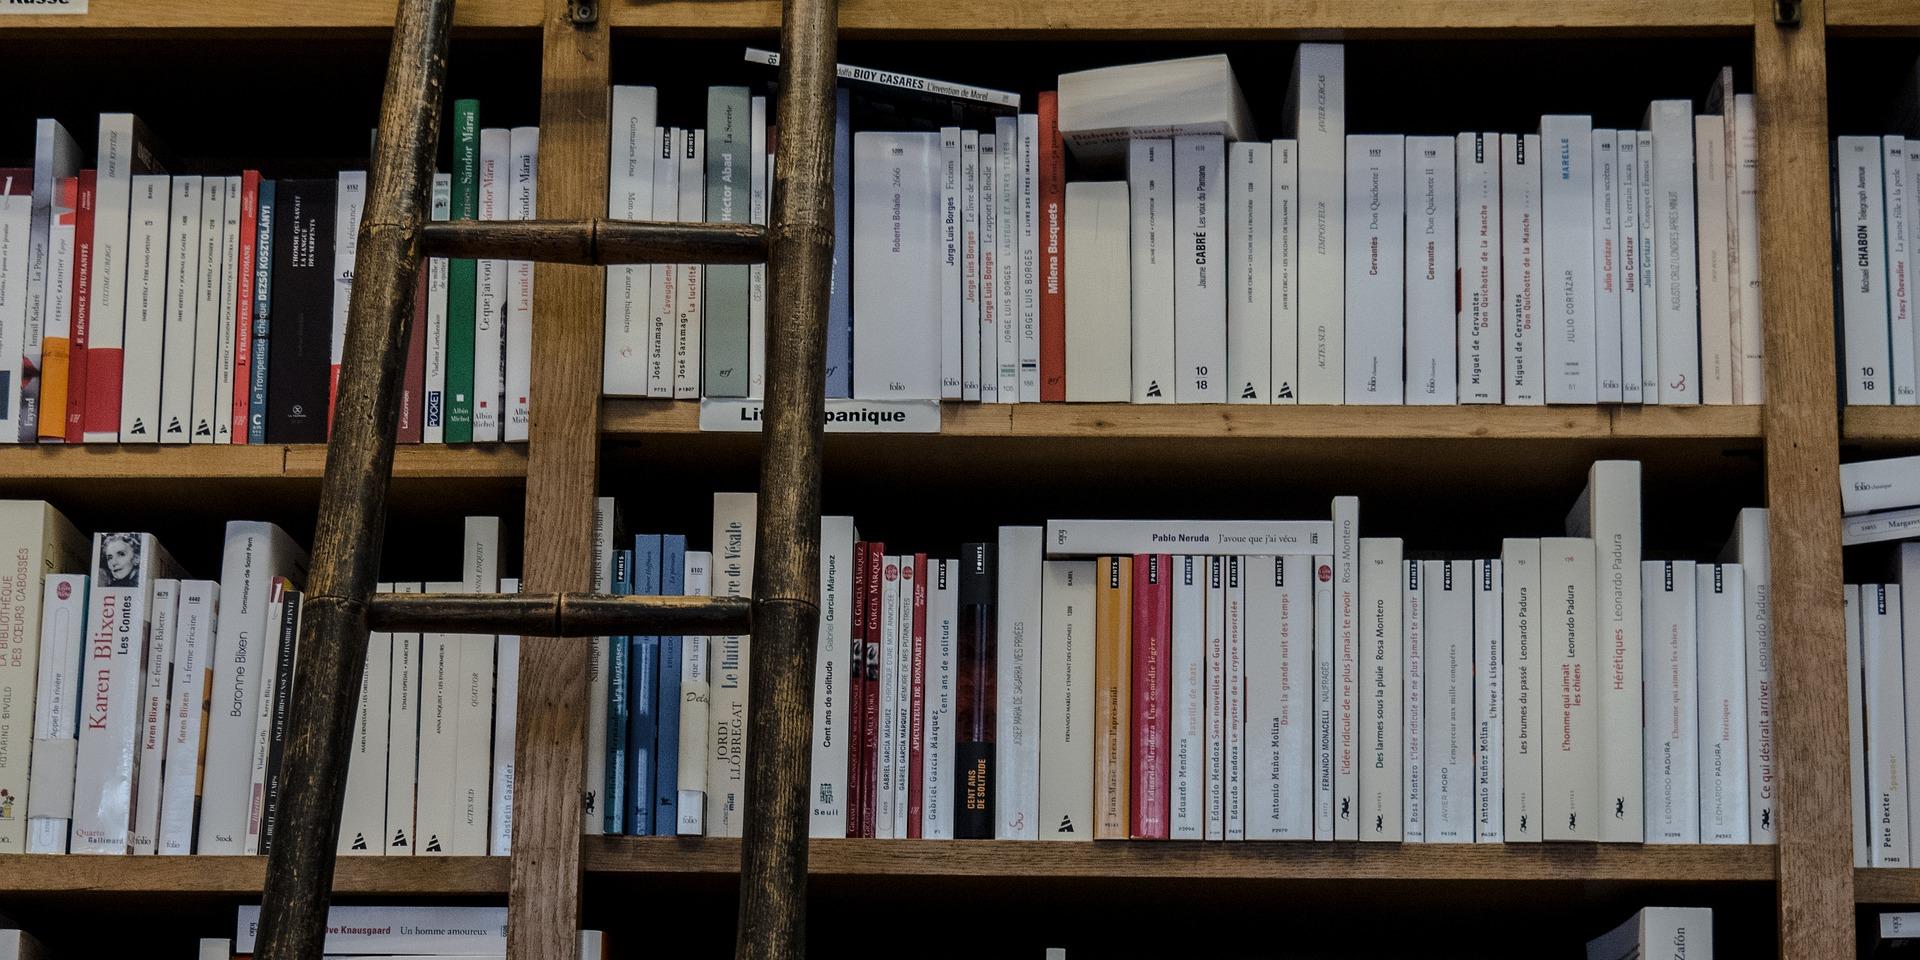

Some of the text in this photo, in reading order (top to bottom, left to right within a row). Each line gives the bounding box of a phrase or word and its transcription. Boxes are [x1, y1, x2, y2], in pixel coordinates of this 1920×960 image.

[854, 70, 924, 89] BIOY CASARES
[461, 112, 474, 185] Sándor Márai
[965, 164, 974, 182] sable
[1561, 138, 1570, 180] MARELLE
[892, 168, 902, 252] Roberto Bolaño 2666
[946, 161, 955, 266] Jorge Luis Borges Fictions
[965, 193, 975, 211] livre
[965, 213, 975, 222] Le
[1522, 214, 1531, 244] Manche
[292, 196, 302, 267] L'HOMME QUI SAVAIT
[308, 219, 316, 251] SERPENTS
[965, 232, 975, 259] Borges
[1048, 204, 1058, 293] Milena Busquets
[1193, 232, 1206, 265] CABRÉ
[1857, 225, 1869, 267] CHABON
[300, 259, 307, 267] LA
[518, 262, 528, 311] La nuit du
[966, 261, 975, 278] Luis
[1480, 205, 1489, 328] Don Quichotte de la Manche
[1523, 258, 1531, 267] de
[966, 280, 975, 303] Jorge
[1024, 249, 1033, 339] JORGE LUIS BORGES
[1523, 271, 1531, 310] Quichotte
[653, 317, 662, 380] José Saramago
[678, 313, 688, 379] José Saramago
[1472, 293, 1481, 384] Miguel de Cervantes
[1514, 295, 1524, 386] Miguel de Cervantes
[1523, 314, 1532, 330] Don
[1196, 367, 1208, 375] 10
[1196, 381, 1208, 390] 18
[1862, 367, 1873, 376] 10
[1863, 382, 1874, 390] 18
[429, 391, 440, 426] POCKET
[824, 408, 905, 424] panique
[722, 522, 742, 577] de Vésale
[1152, 533, 1209, 543] Pablo Neruda
[1341, 520, 1352, 583] Rosa Montero
[1611, 534, 1624, 622] Leonardo Padura
[117, 595, 130, 654] Les Contes
[1374, 600, 1384, 660] Rosa Montero
[1518, 587, 1528, 660] Leonardo Padura
[1566, 585, 1575, 658] Leonardo Padura
[88, 595, 116, 730] Karen Blixen
[230, 632, 248, 716] Baronne Blixen
[722, 674, 738, 688] Le
[940, 620, 950, 714] Cent ans de solitude
[1280, 593, 1289, 725] Dans la grande nuit des temps
[1340, 591, 1352, 775] L'idée ridicule de ne plus jamais te revoir
[1572, 664, 1580, 706] les chiens
[1612, 629, 1624, 690] Hérétiques
[146, 697, 159, 750] Karen Blixen
[823, 661, 834, 748] Cent ans de solitude
[1374, 666, 1385, 768] Des larmes sous la pluie
[1518, 667, 1528, 754] Les brumes du passé
[1561, 664, 1571, 752] L'homme qui aimait
[716, 722, 730, 760] JORDI
[730, 702, 743, 780] LLOBREGAT
[1321, 710, 1330, 791] FERNANDO MONACELLI
[1758, 680, 1772, 799] Ce qui désirait arriver
[967, 770, 975, 809] CENT ANS
[977, 759, 986, 809] DE SOLITUDE
[1178, 739, 1187, 818] Eduardo Mendoza
[1664, 741, 1672, 824] LEONARDO PADURA
[1881, 792, 1891, 848] Pete Dexter
[341, 926, 391, 937] Knausgaard
[400, 926, 487, 936] Un homme amoureux
